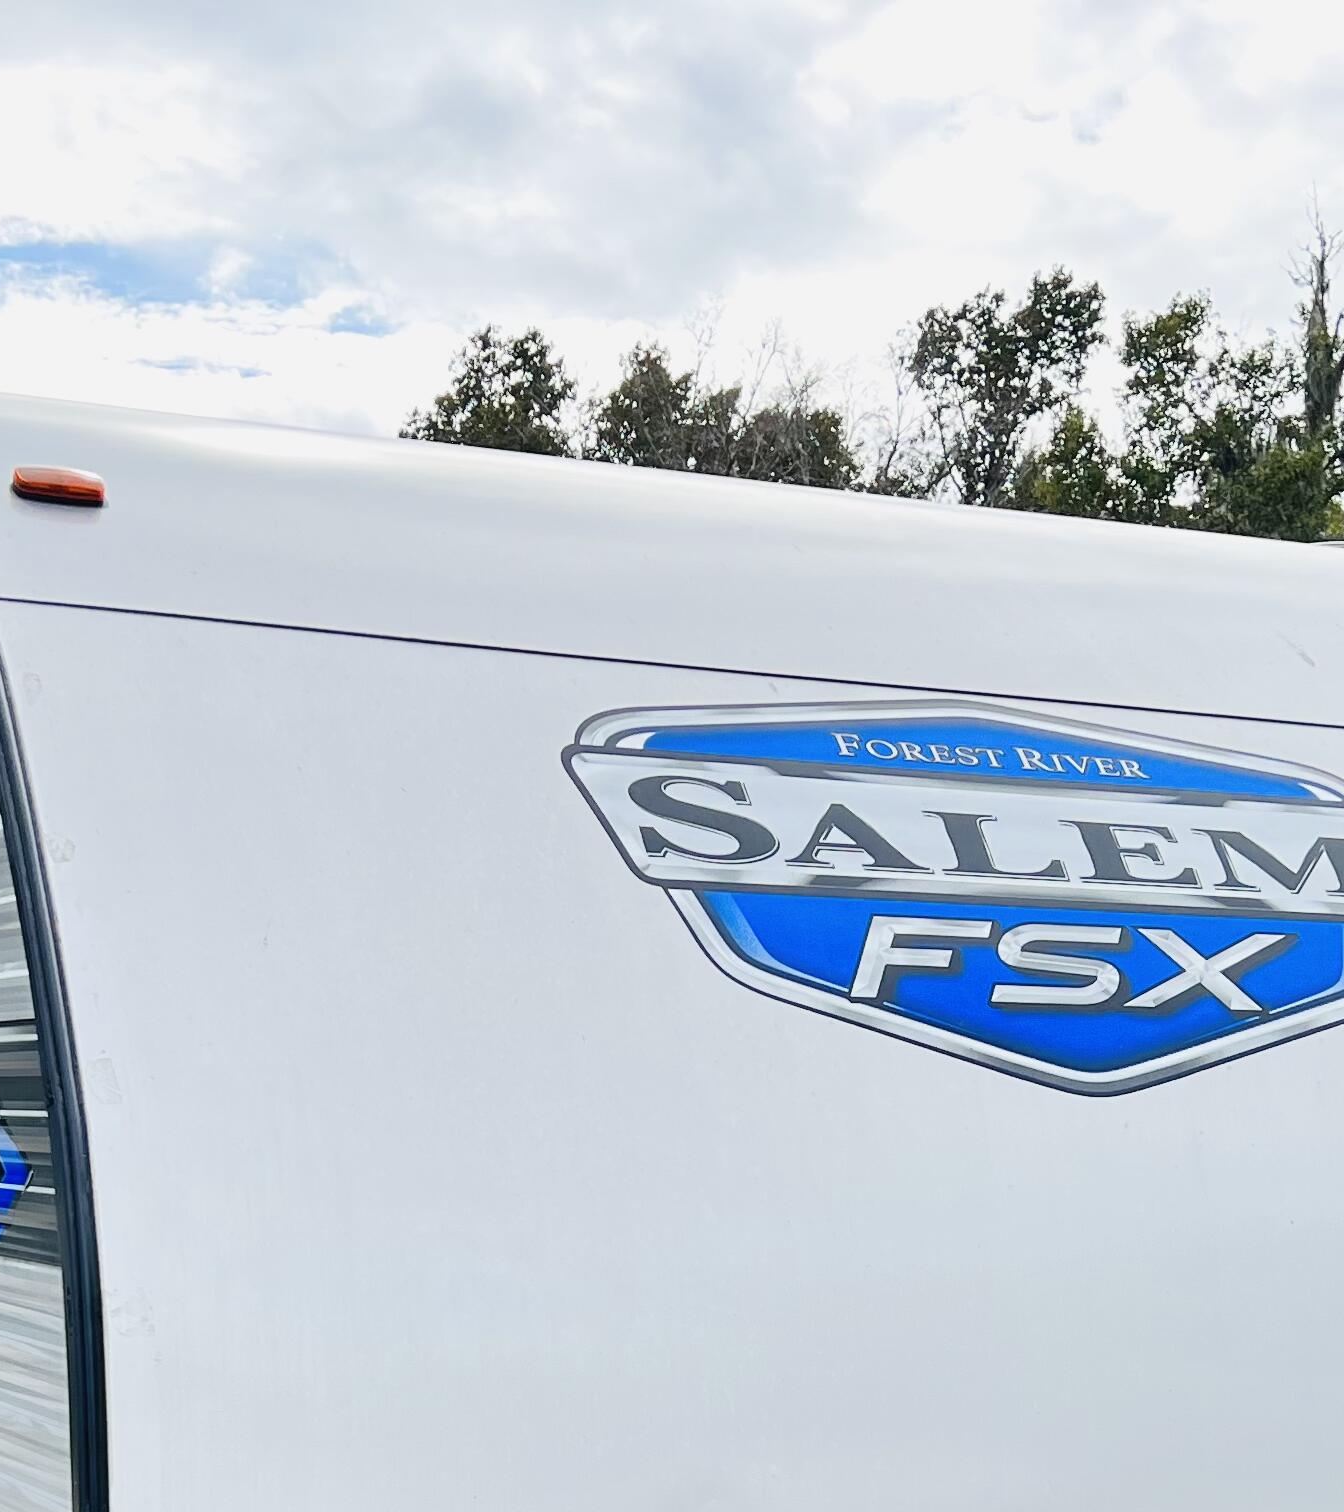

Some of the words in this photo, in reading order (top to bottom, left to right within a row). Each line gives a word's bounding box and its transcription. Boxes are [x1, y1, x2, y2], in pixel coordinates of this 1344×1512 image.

[831, 732, 1004, 768] FOREST
[1013, 747, 1151, 779] RIVER
[850, 914, 1288, 1012] FSX
